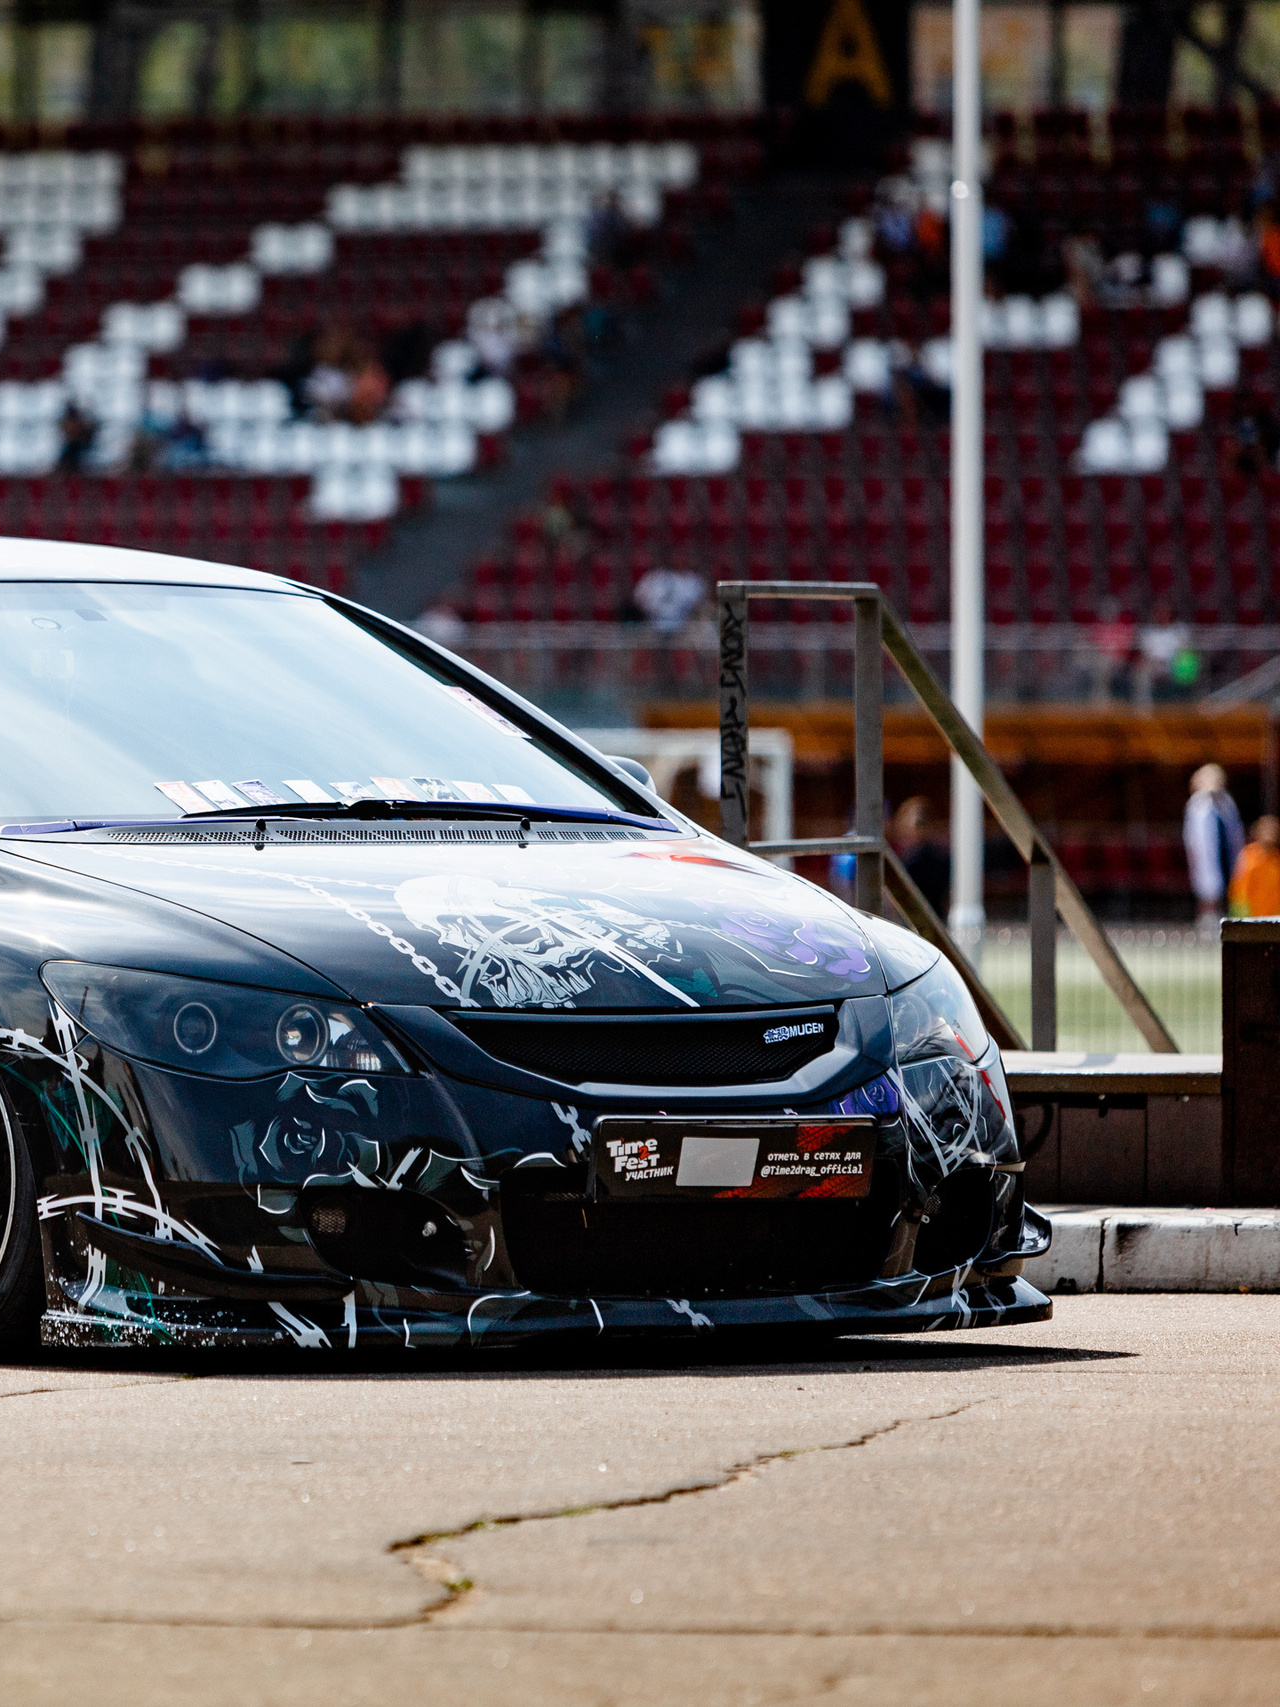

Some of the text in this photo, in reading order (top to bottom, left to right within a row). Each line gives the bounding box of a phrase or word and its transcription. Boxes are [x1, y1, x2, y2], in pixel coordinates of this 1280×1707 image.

[790, 1023, 824, 1037] MUGEN
[607, 1138, 658, 1158] Time
[767, 1150, 862, 1162] отметь в сетях для
[625, 1166, 674, 1181] УЧАСТНИК
[760, 1164, 863, 1178] @Time2drag_official
